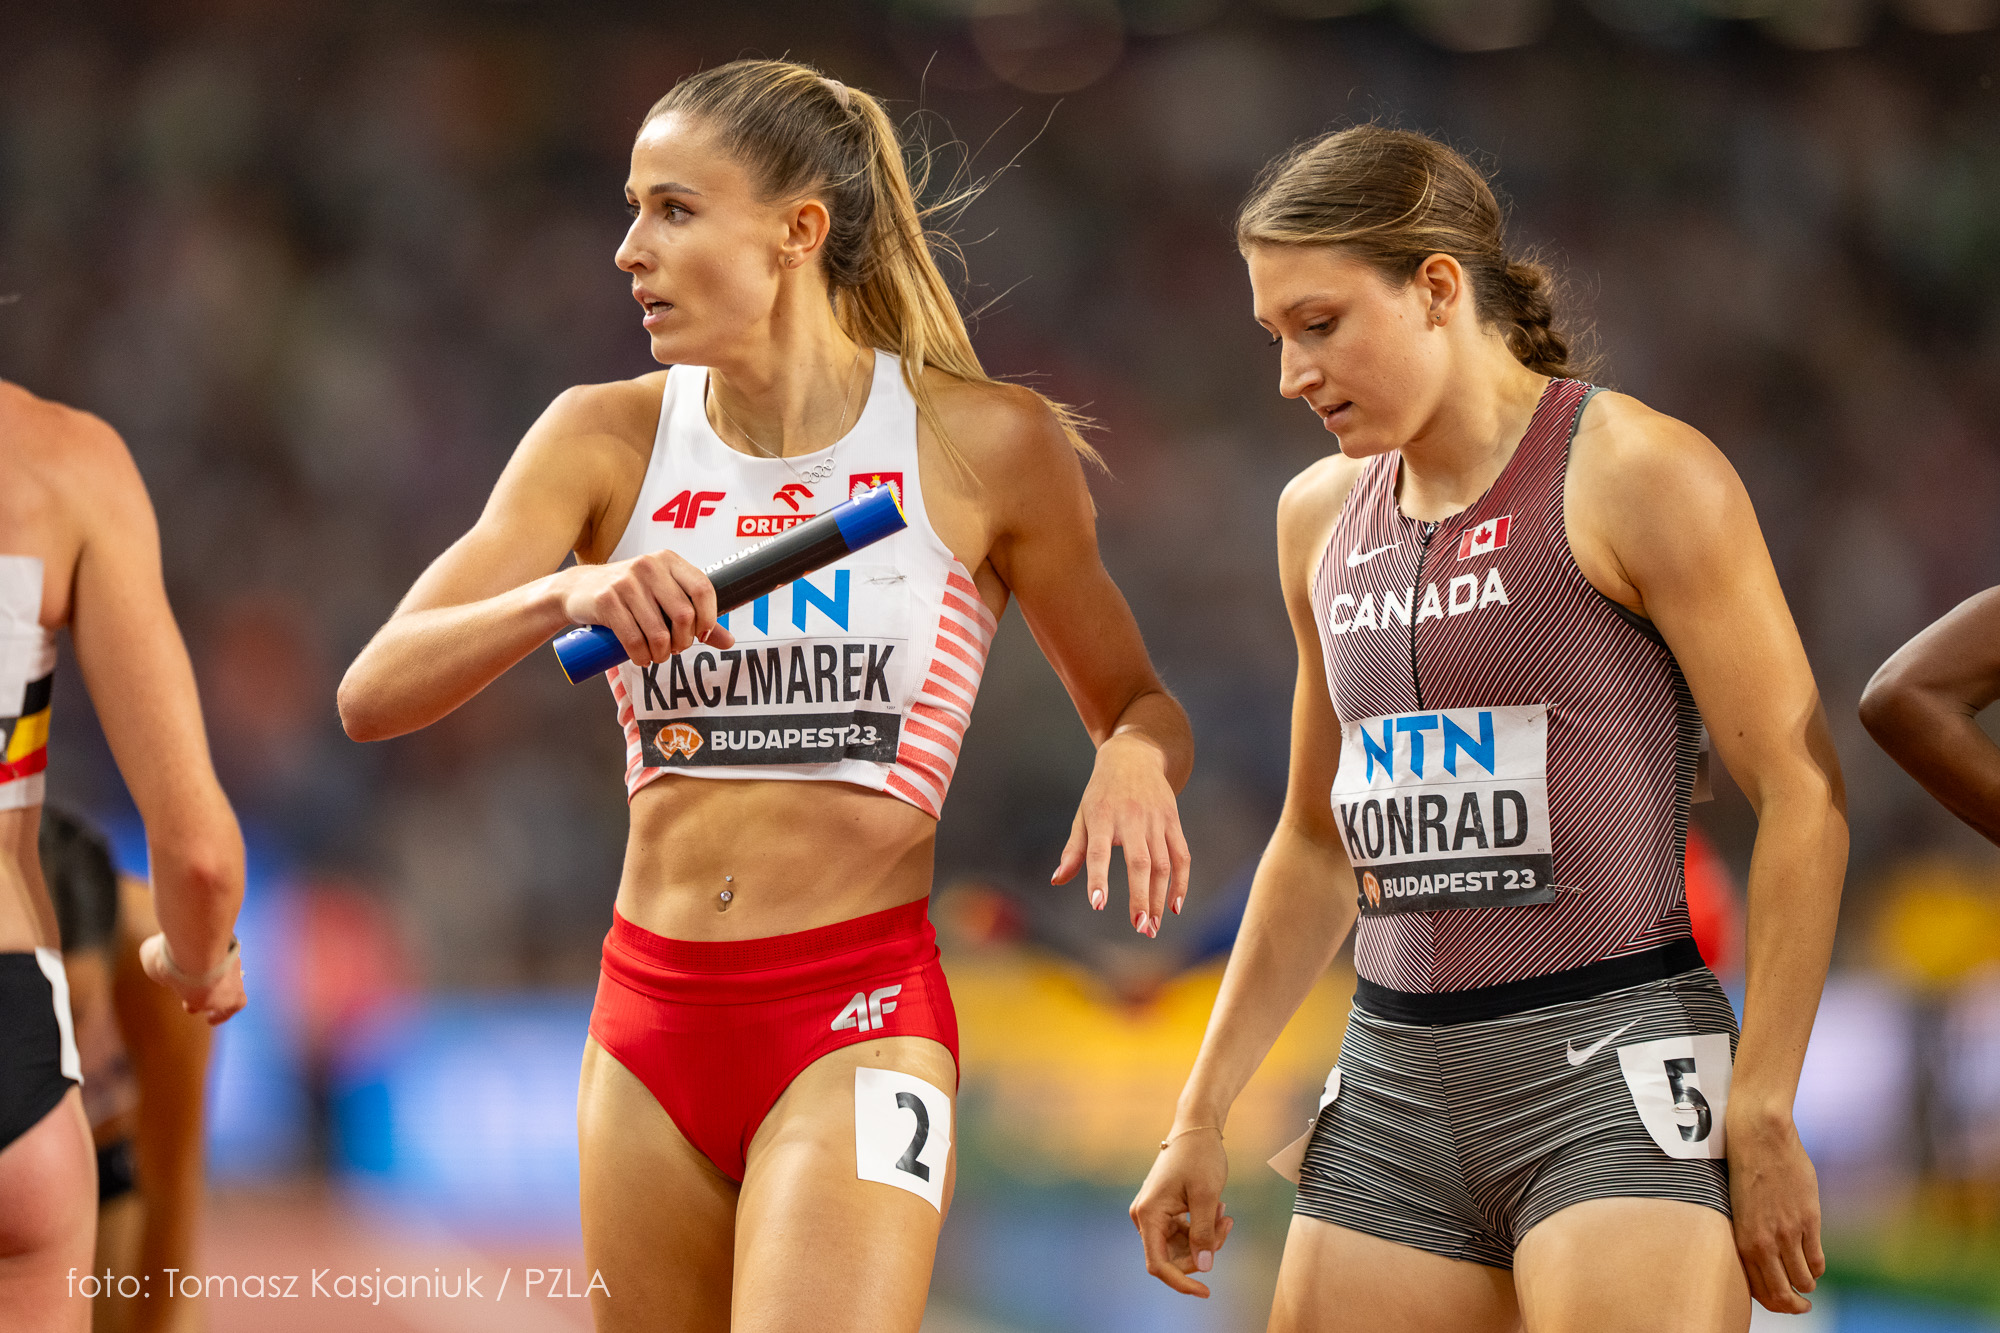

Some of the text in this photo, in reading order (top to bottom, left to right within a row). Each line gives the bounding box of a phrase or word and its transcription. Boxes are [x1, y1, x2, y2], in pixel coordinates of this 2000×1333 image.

[652, 490, 726, 528] 4F
[1329, 567, 1510, 635] CANADA
[641, 643, 895, 711] KACZMAREK
[711, 727, 849, 750] BUDAPEST
[1360, 712, 1494, 784] NTN
[1340, 790, 1529, 860] KONRAD
[1383, 869, 1536, 899] BUDAPEST 23
[830, 984, 902, 1032] 4F
[1663, 1058, 1712, 1143] 5
[895, 1092, 930, 1182] 2
